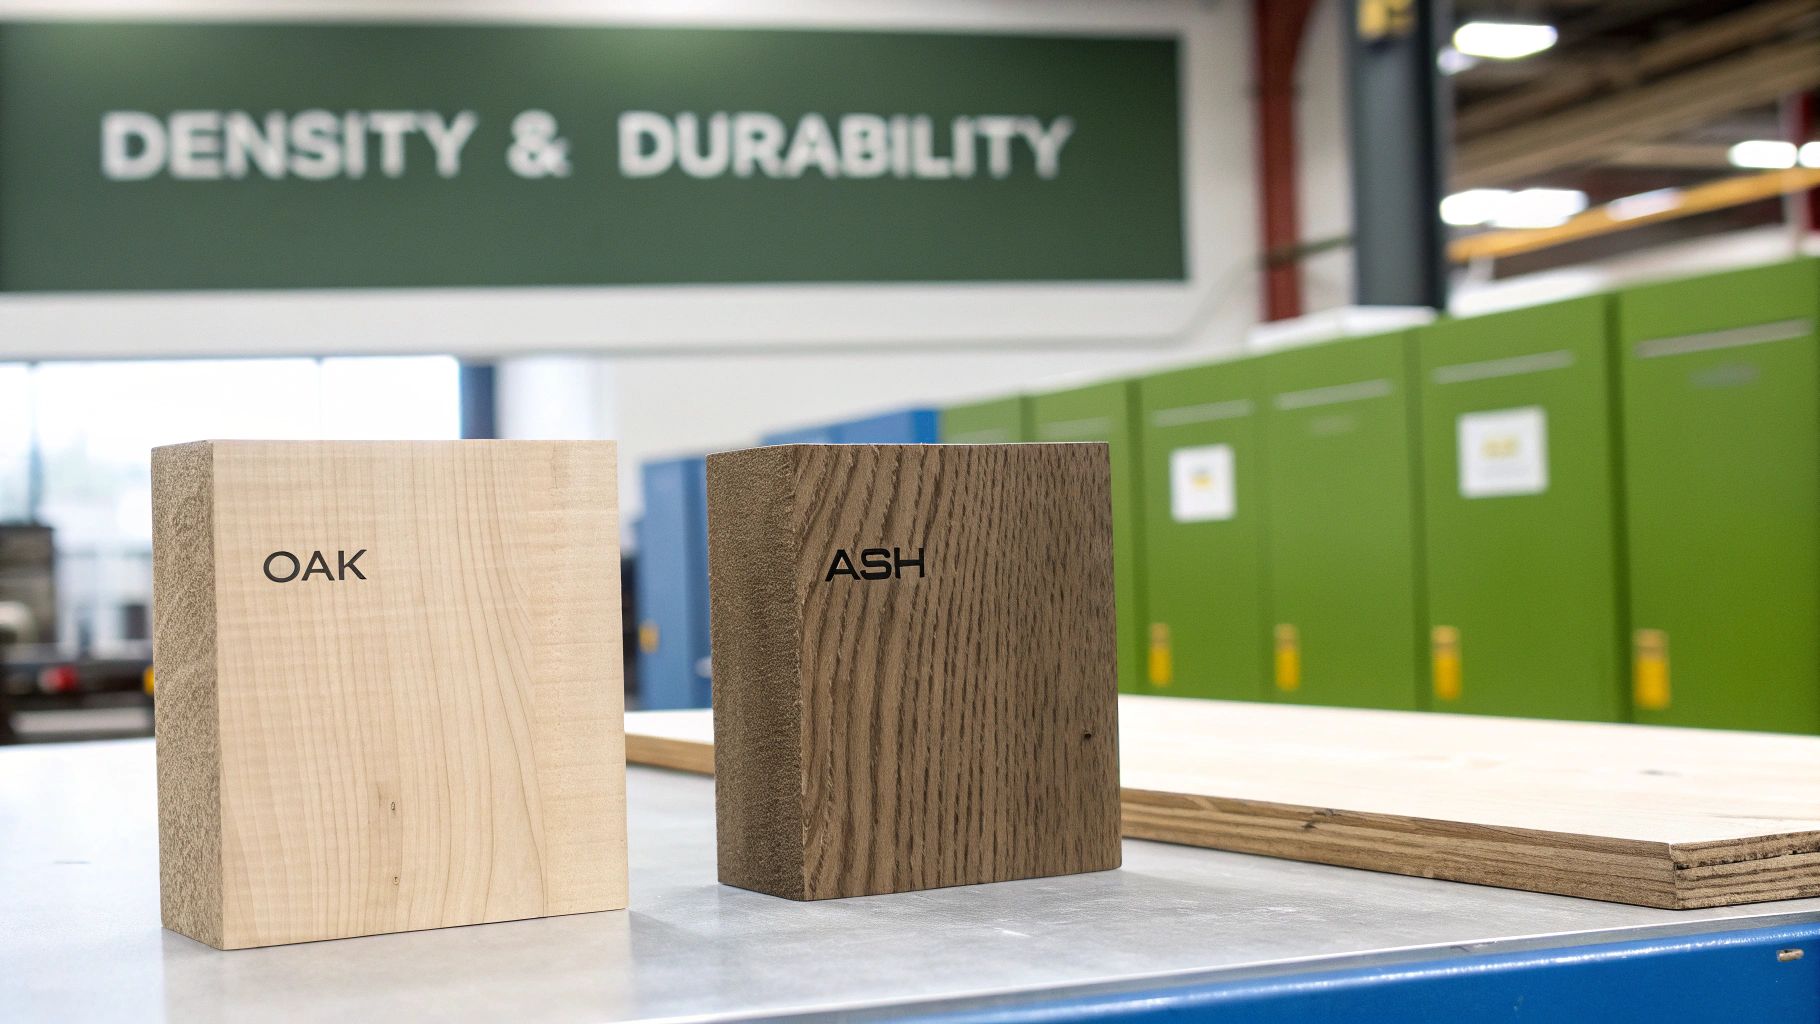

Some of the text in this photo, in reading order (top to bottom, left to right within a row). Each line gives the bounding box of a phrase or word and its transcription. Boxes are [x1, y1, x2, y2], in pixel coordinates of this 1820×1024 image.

[102, 109, 1072, 180] DENSITY & DURABILITY
[263, 548, 368, 582] OAK
[825, 545, 926, 581] ASH
